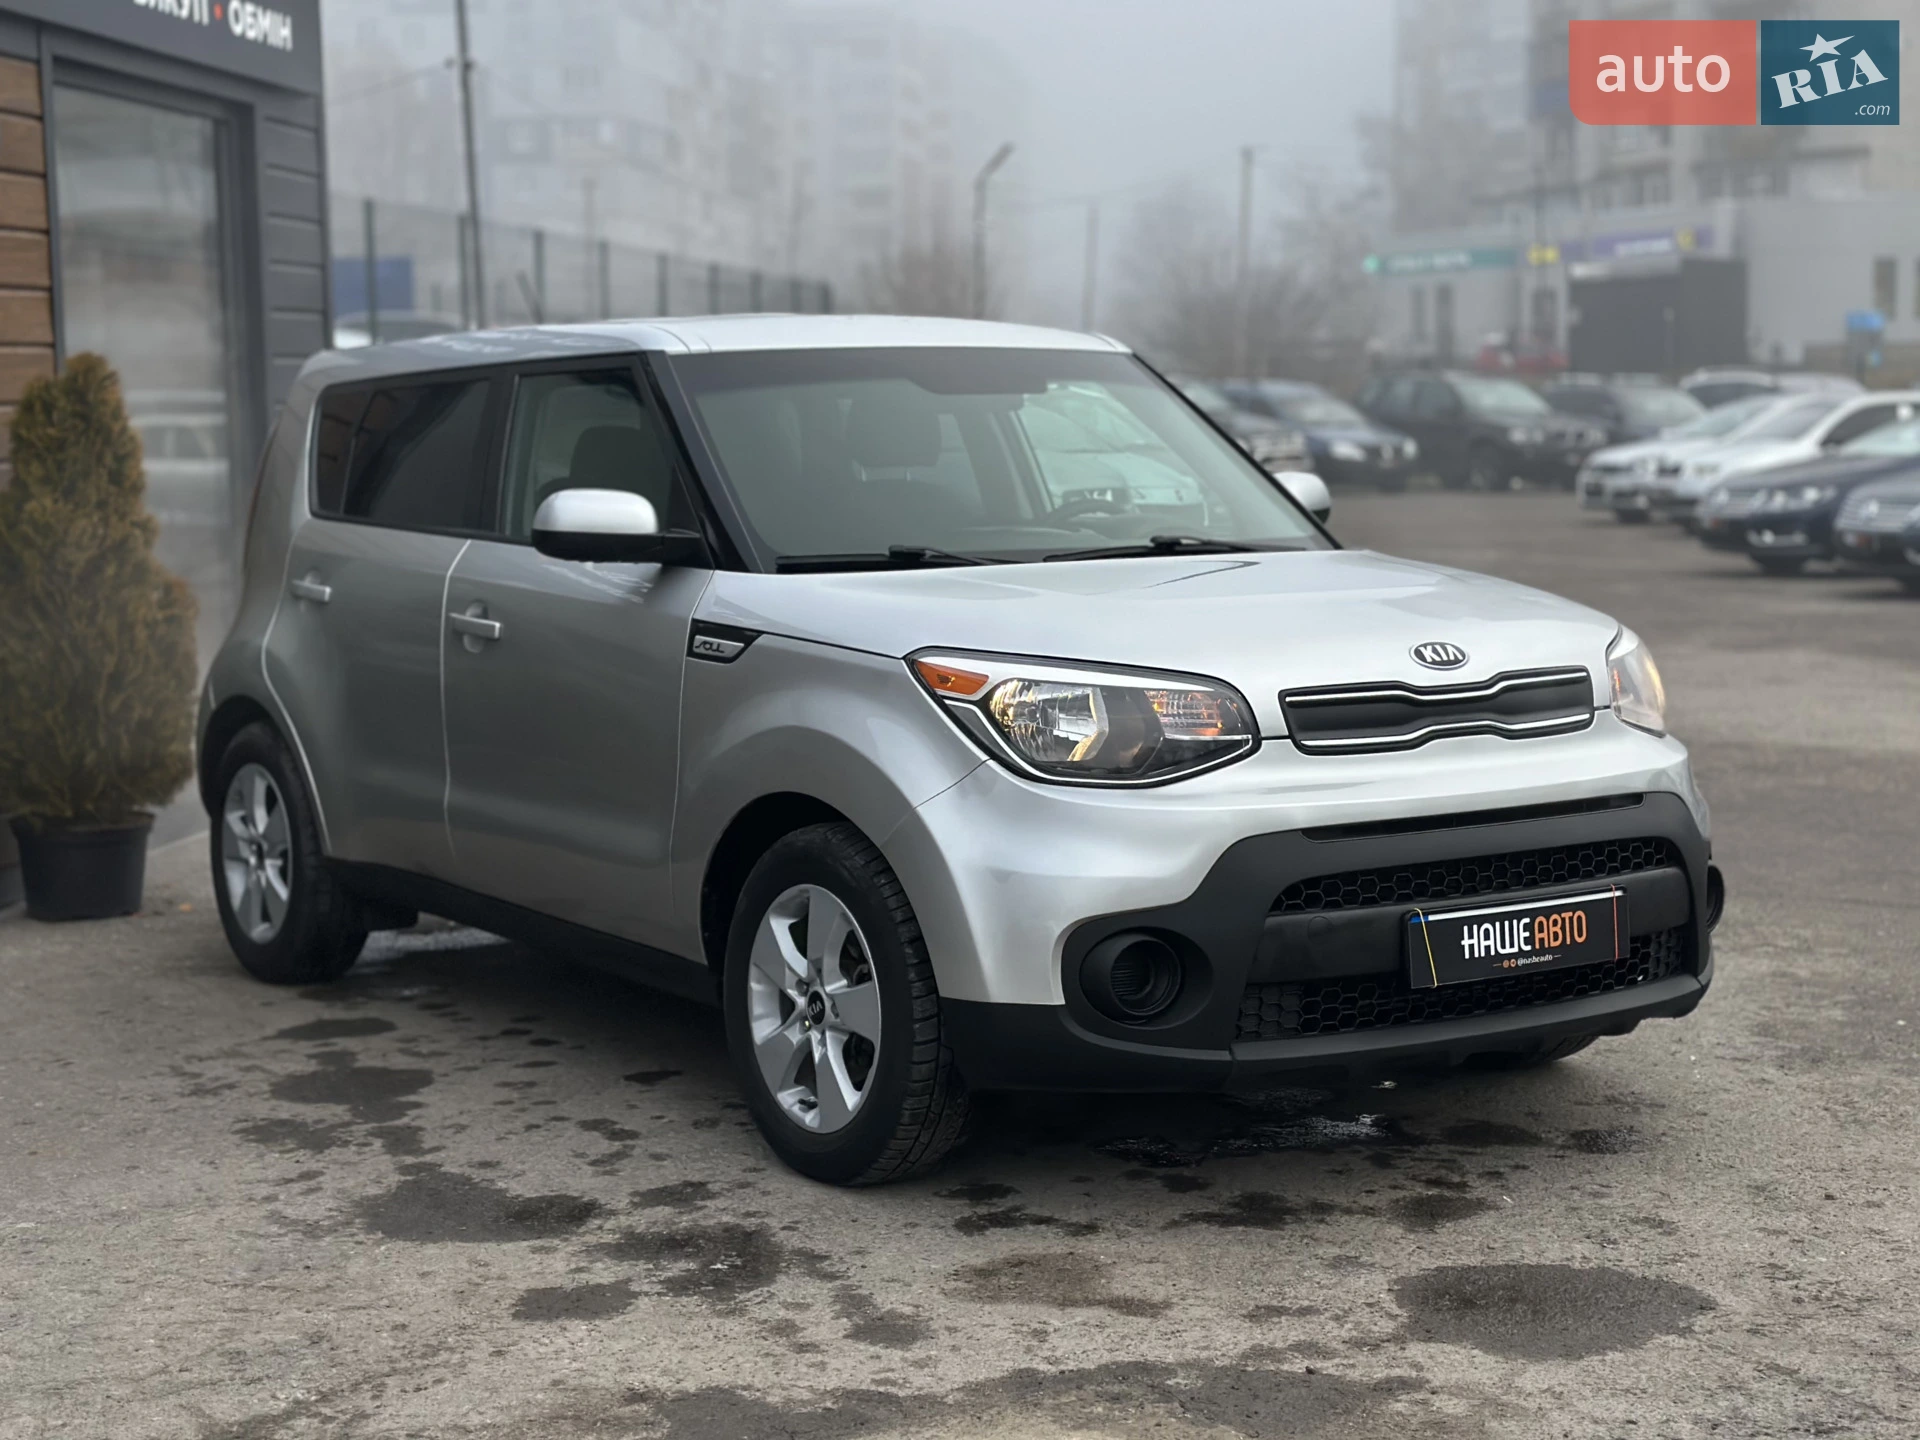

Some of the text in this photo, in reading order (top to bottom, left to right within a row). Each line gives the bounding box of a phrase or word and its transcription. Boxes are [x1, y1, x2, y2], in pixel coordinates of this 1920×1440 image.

[228, 0, 293, 52] ОБМІН
[1417, 644, 1464, 662] KIA
[807, 1000, 823, 1016] KIA
